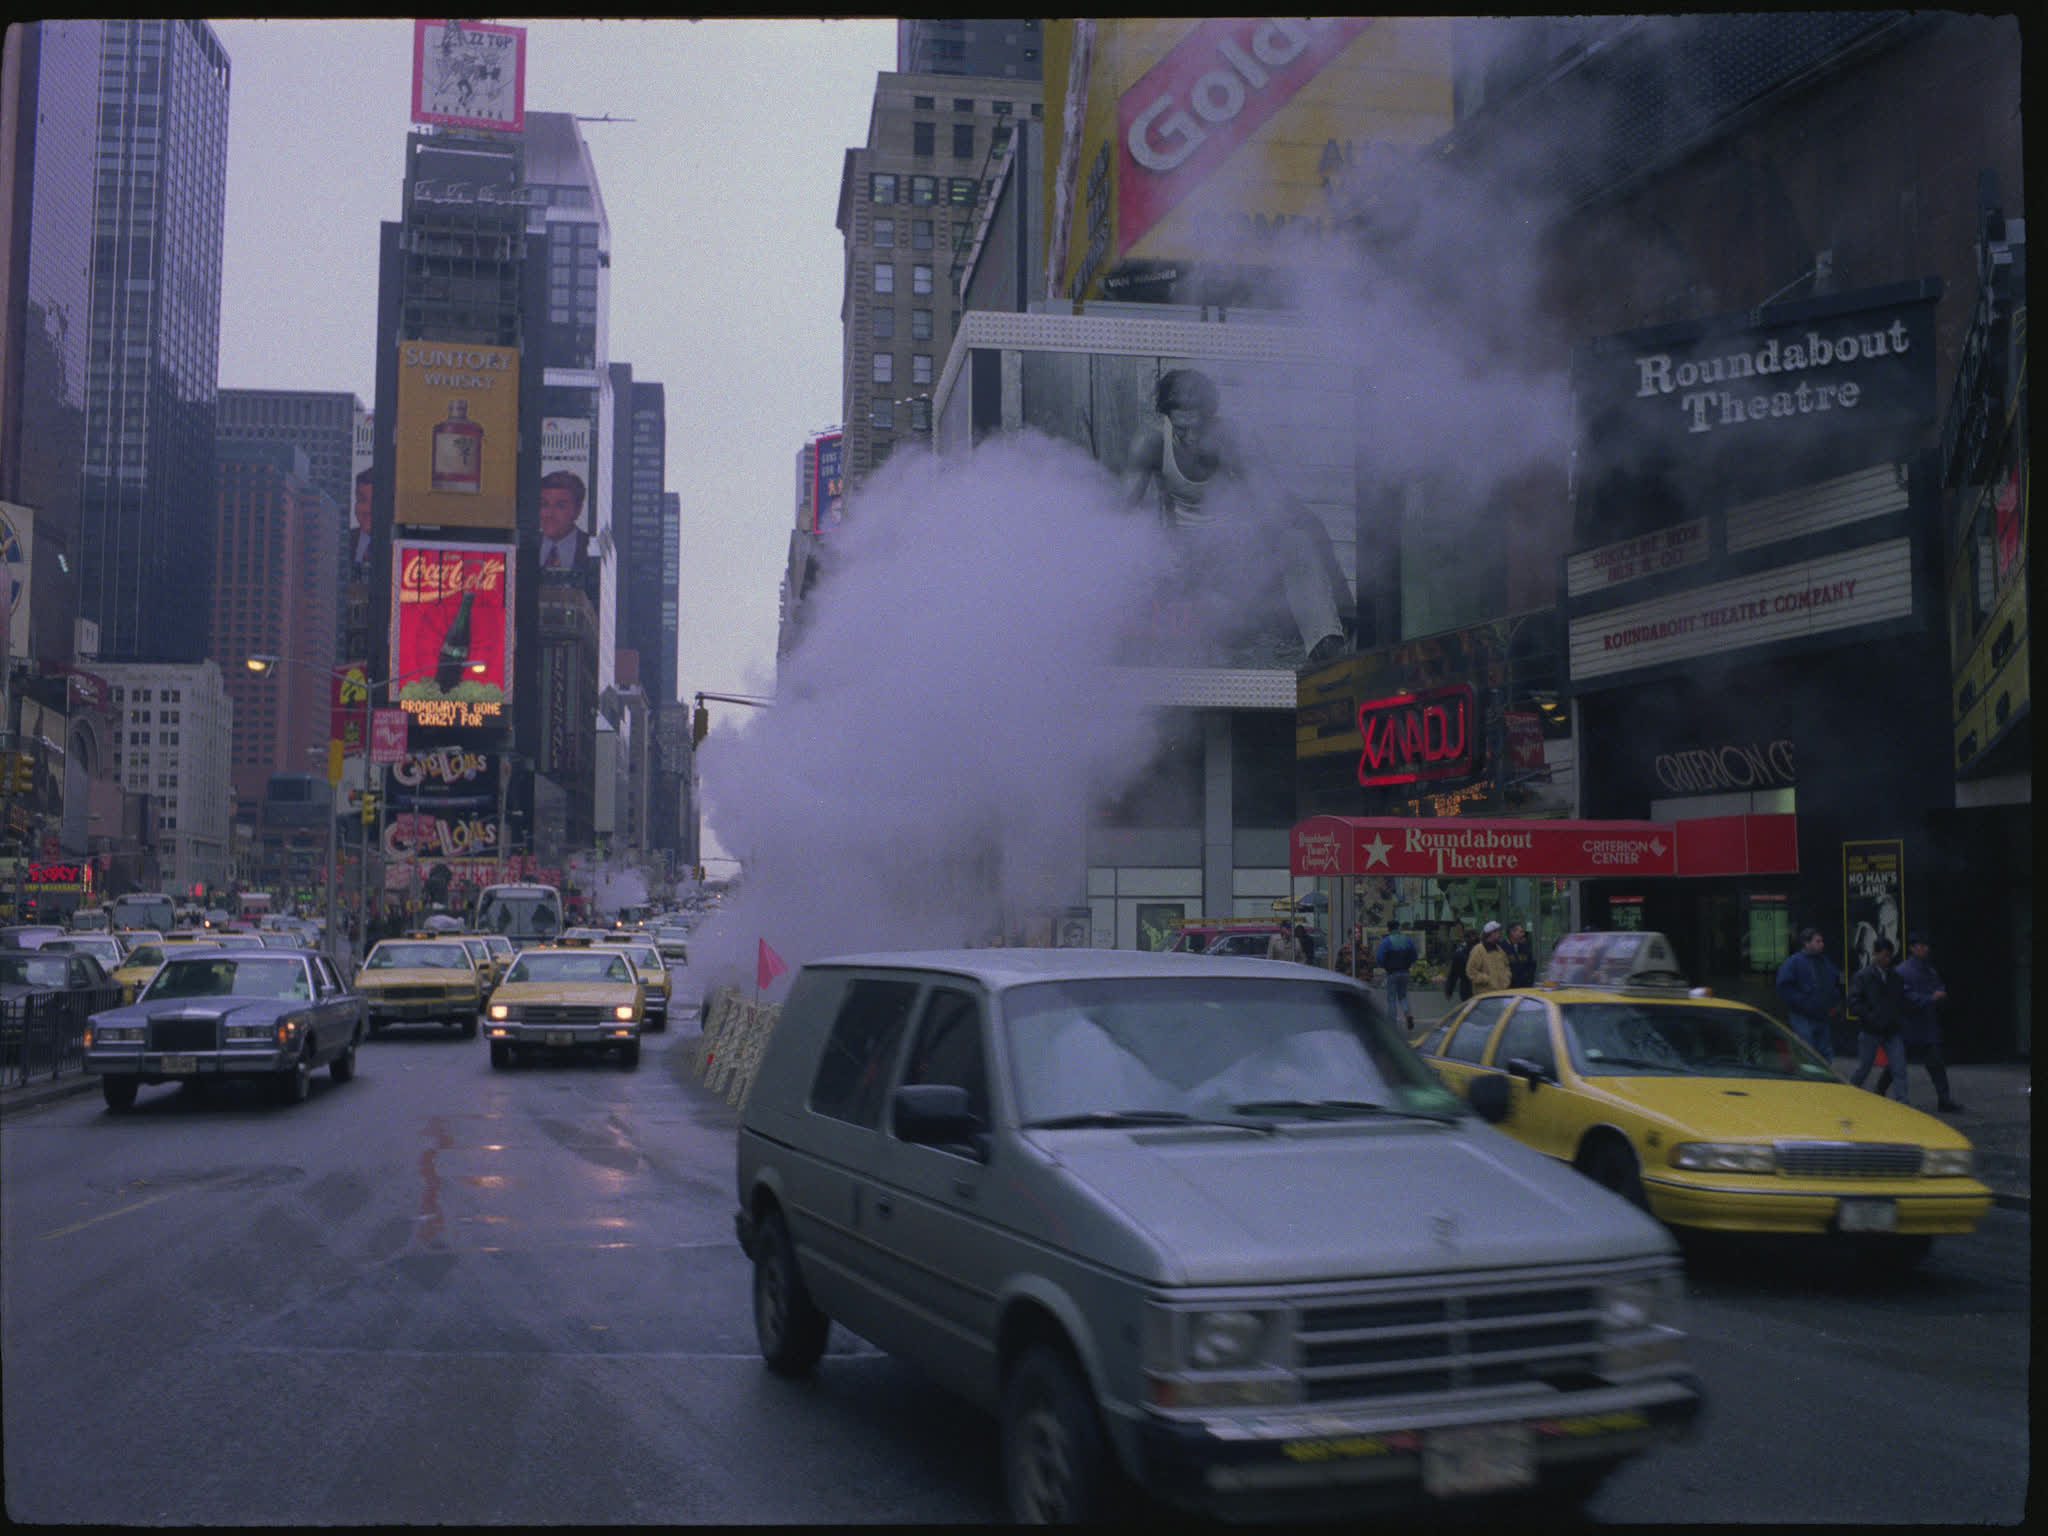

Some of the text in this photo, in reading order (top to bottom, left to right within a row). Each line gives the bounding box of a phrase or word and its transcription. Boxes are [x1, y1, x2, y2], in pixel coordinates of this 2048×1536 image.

[469, 31, 513, 49] ZZ TOP
[1127, 17, 1309, 170] Gold
[1109, 276, 1130, 288] VAN
[406, 346, 512, 371] SUNTORY
[1635, 319, 1910, 398] Roundabout
[423, 369, 495, 389] WHISKY
[1681, 379, 1861, 433] Theatre
[1603, 578, 1857, 651] ROUNDABOUT THEATRE COMPANY
[473, 701, 502, 716] GONE
[418, 712, 455, 727] CRAZY
[460, 713, 483, 727] FOR
[1359, 698, 1465, 769] XANADU
[1404, 827, 1533, 853] Roundabout
[1582, 839, 1649, 853] CRITERION
[1428, 847, 1519, 875] Theatre
[1591, 852, 1640, 865] CENTER
[1849, 871, 1898, 885] NO MAN'S
[1860, 884, 1886, 896] LAND
